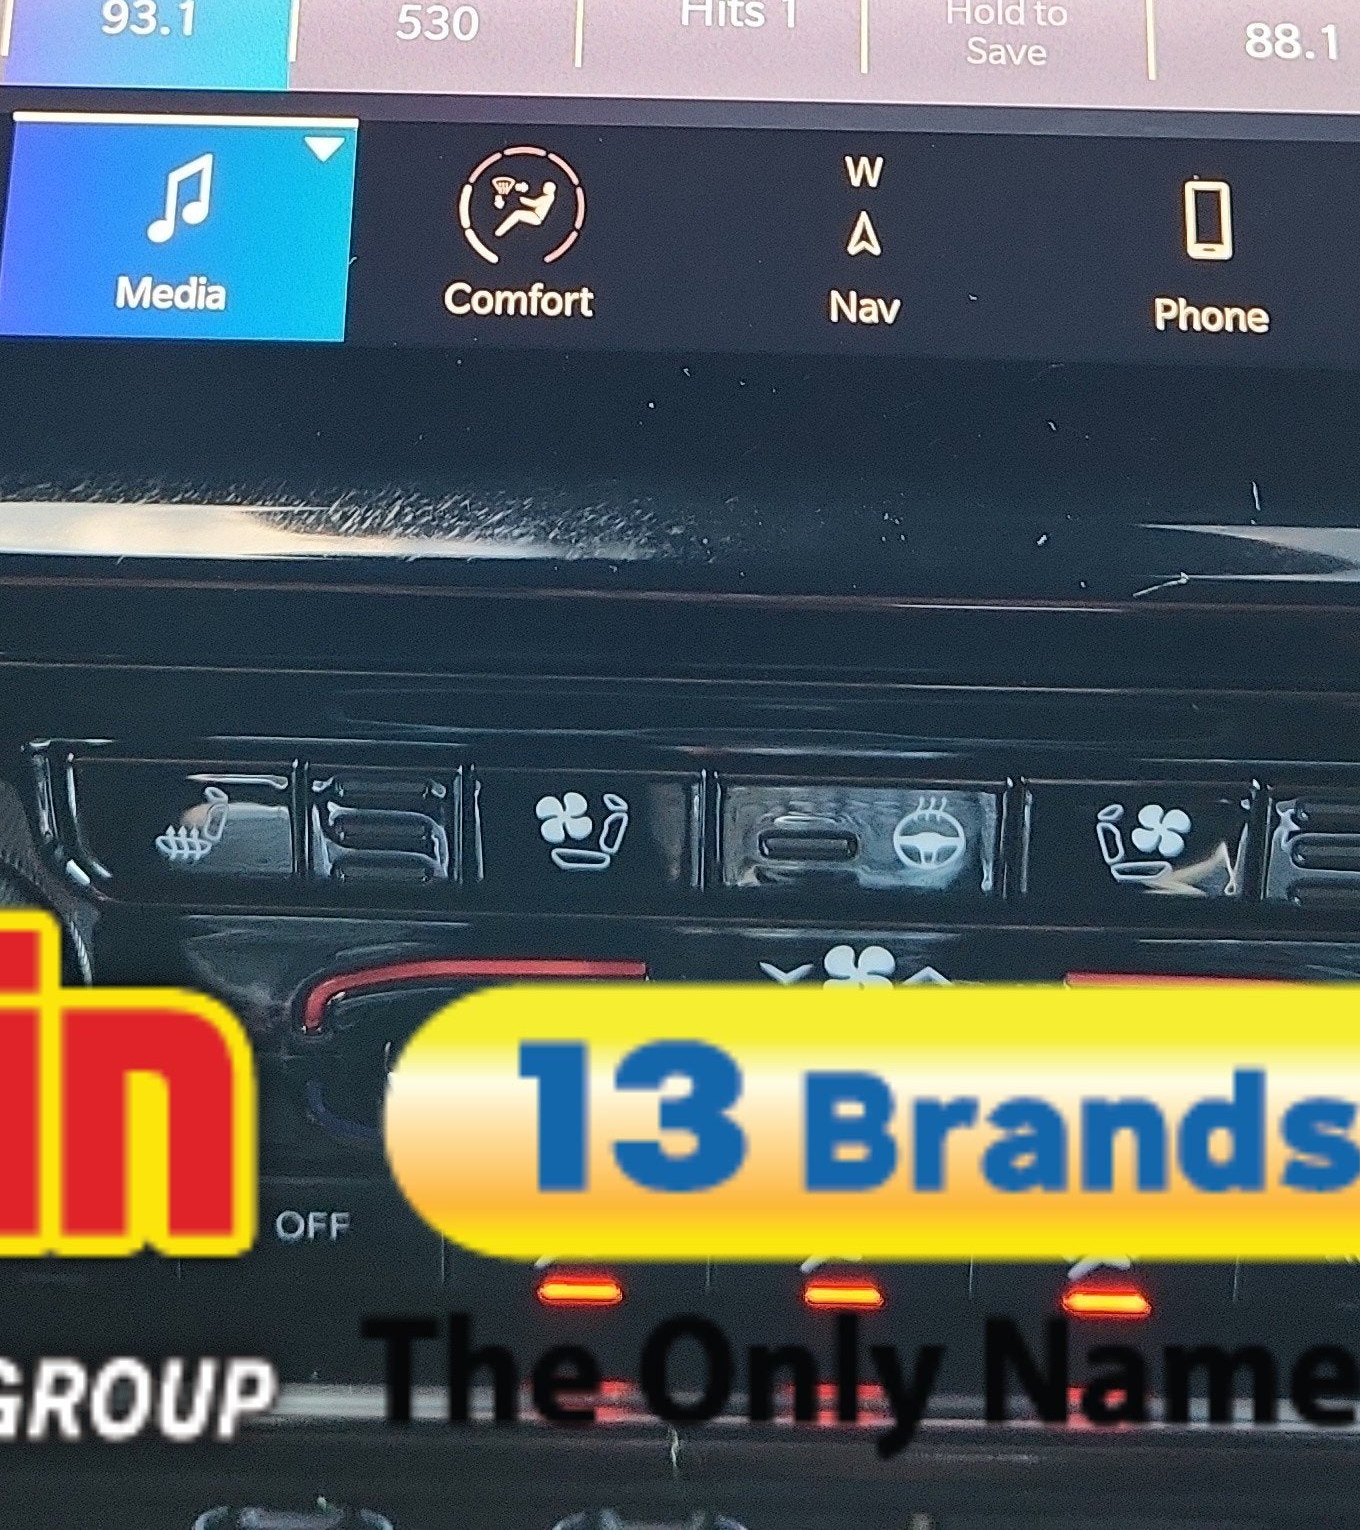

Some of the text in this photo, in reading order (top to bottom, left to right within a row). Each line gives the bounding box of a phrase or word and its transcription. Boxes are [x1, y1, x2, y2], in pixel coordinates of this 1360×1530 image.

[396, 4, 479, 41] 530
[1034, 1, 1068, 27] to
[966, 36, 1047, 66] Save
[1245, 22, 1338, 60] 88.1
[844, 155, 884, 188] W
[115, 275, 227, 311] Media
[444, 282, 595, 318] Comfort
[830, 289, 901, 324] Nav
[1154, 297, 1270, 333] Phone
[275, 1210, 349, 1240] OFF
